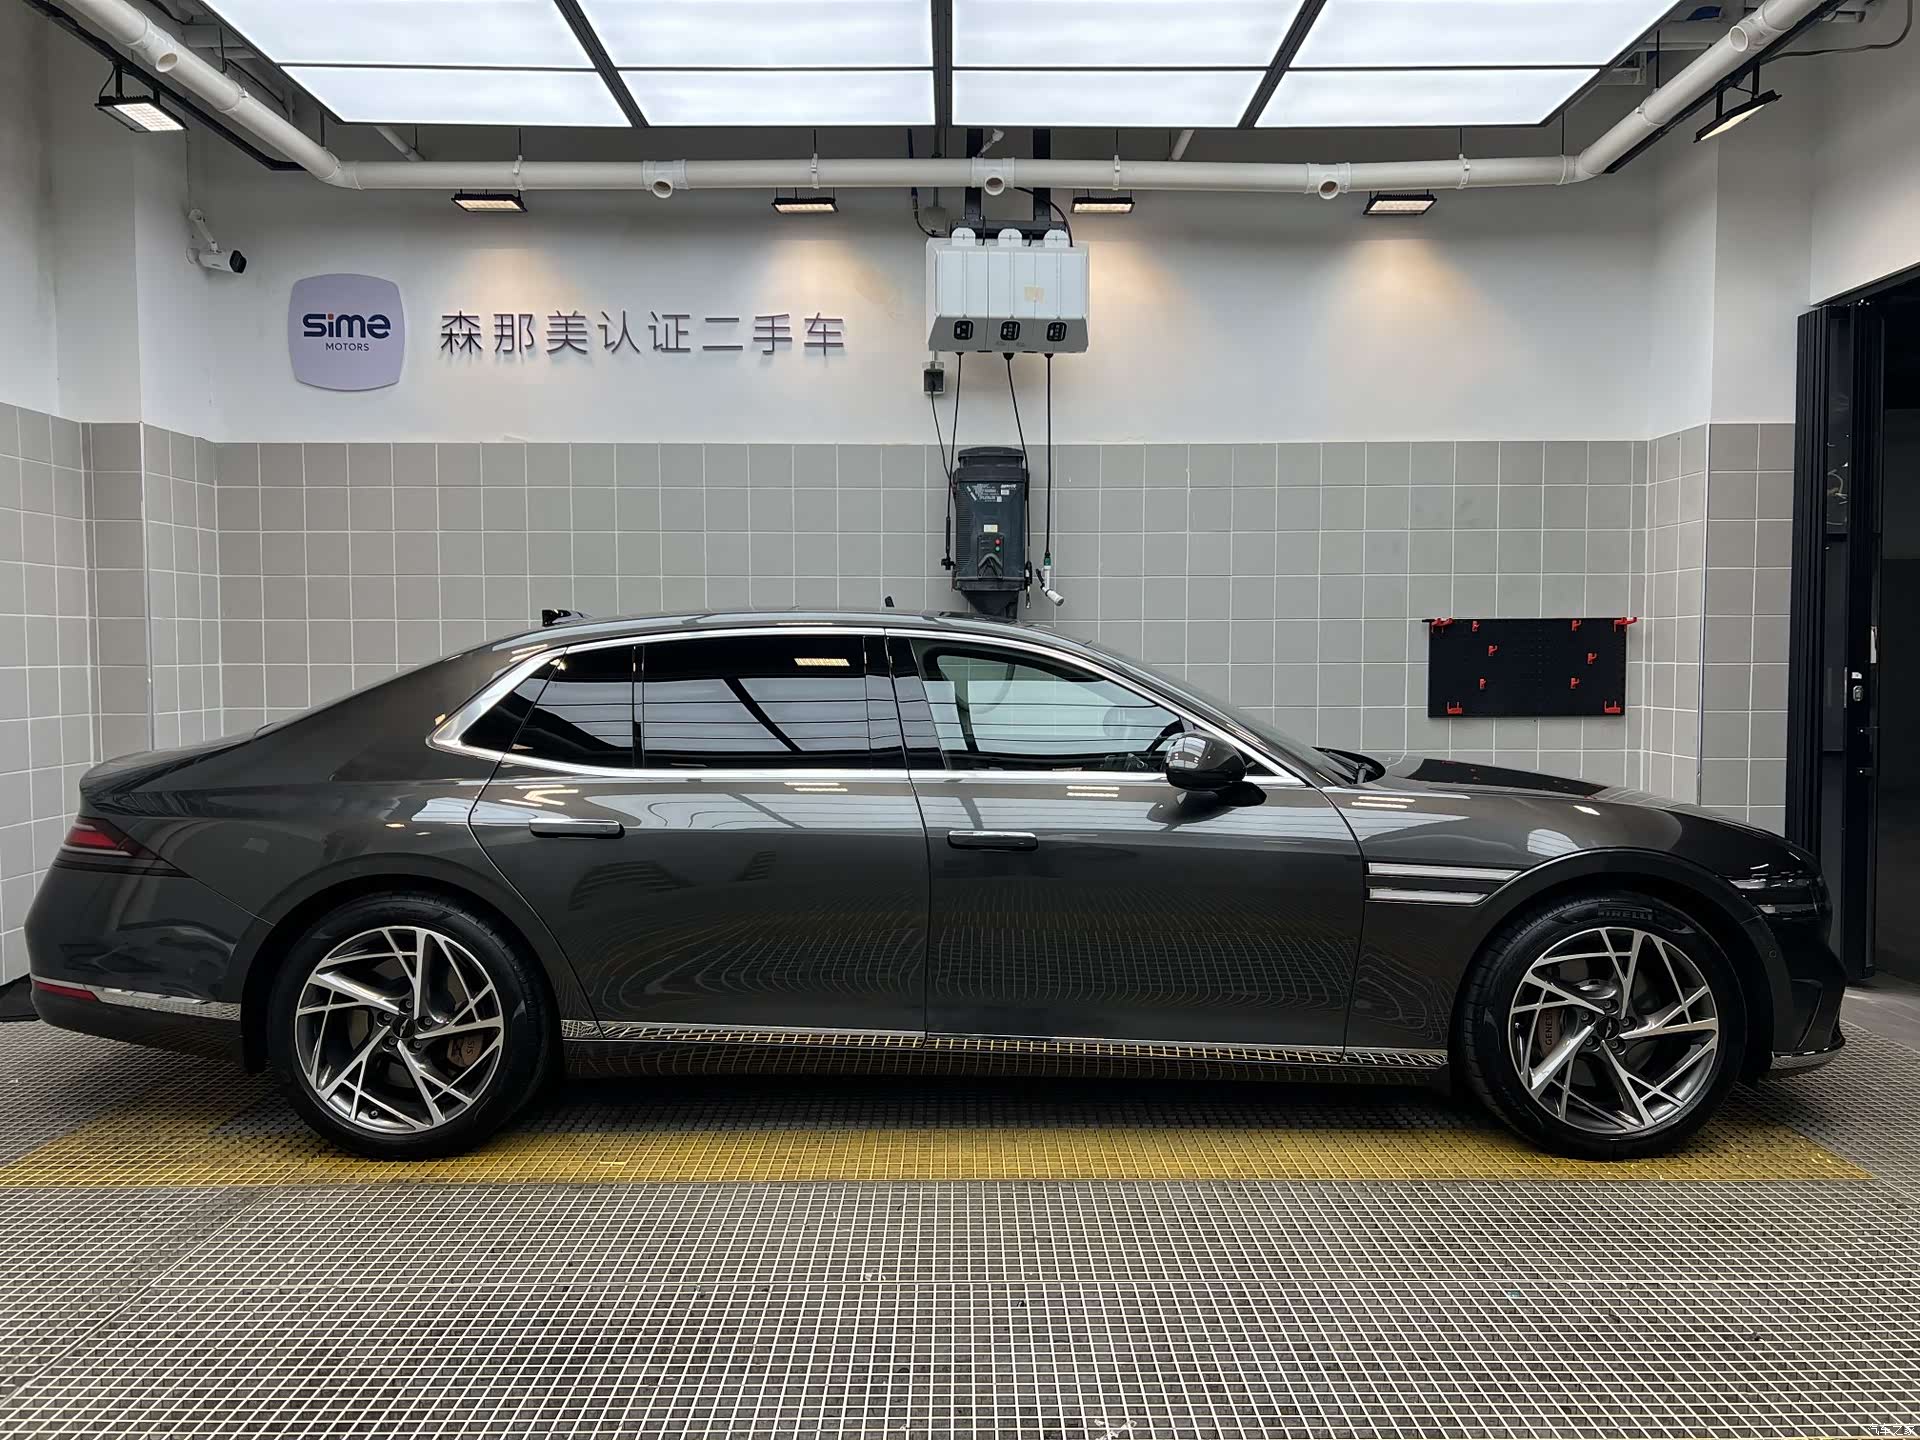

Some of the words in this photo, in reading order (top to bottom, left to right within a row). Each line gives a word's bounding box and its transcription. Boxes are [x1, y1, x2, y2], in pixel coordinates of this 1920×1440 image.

[325, 342, 370, 352] MOTORS
[440, 310, 844, 356] 森那美认证二手车
